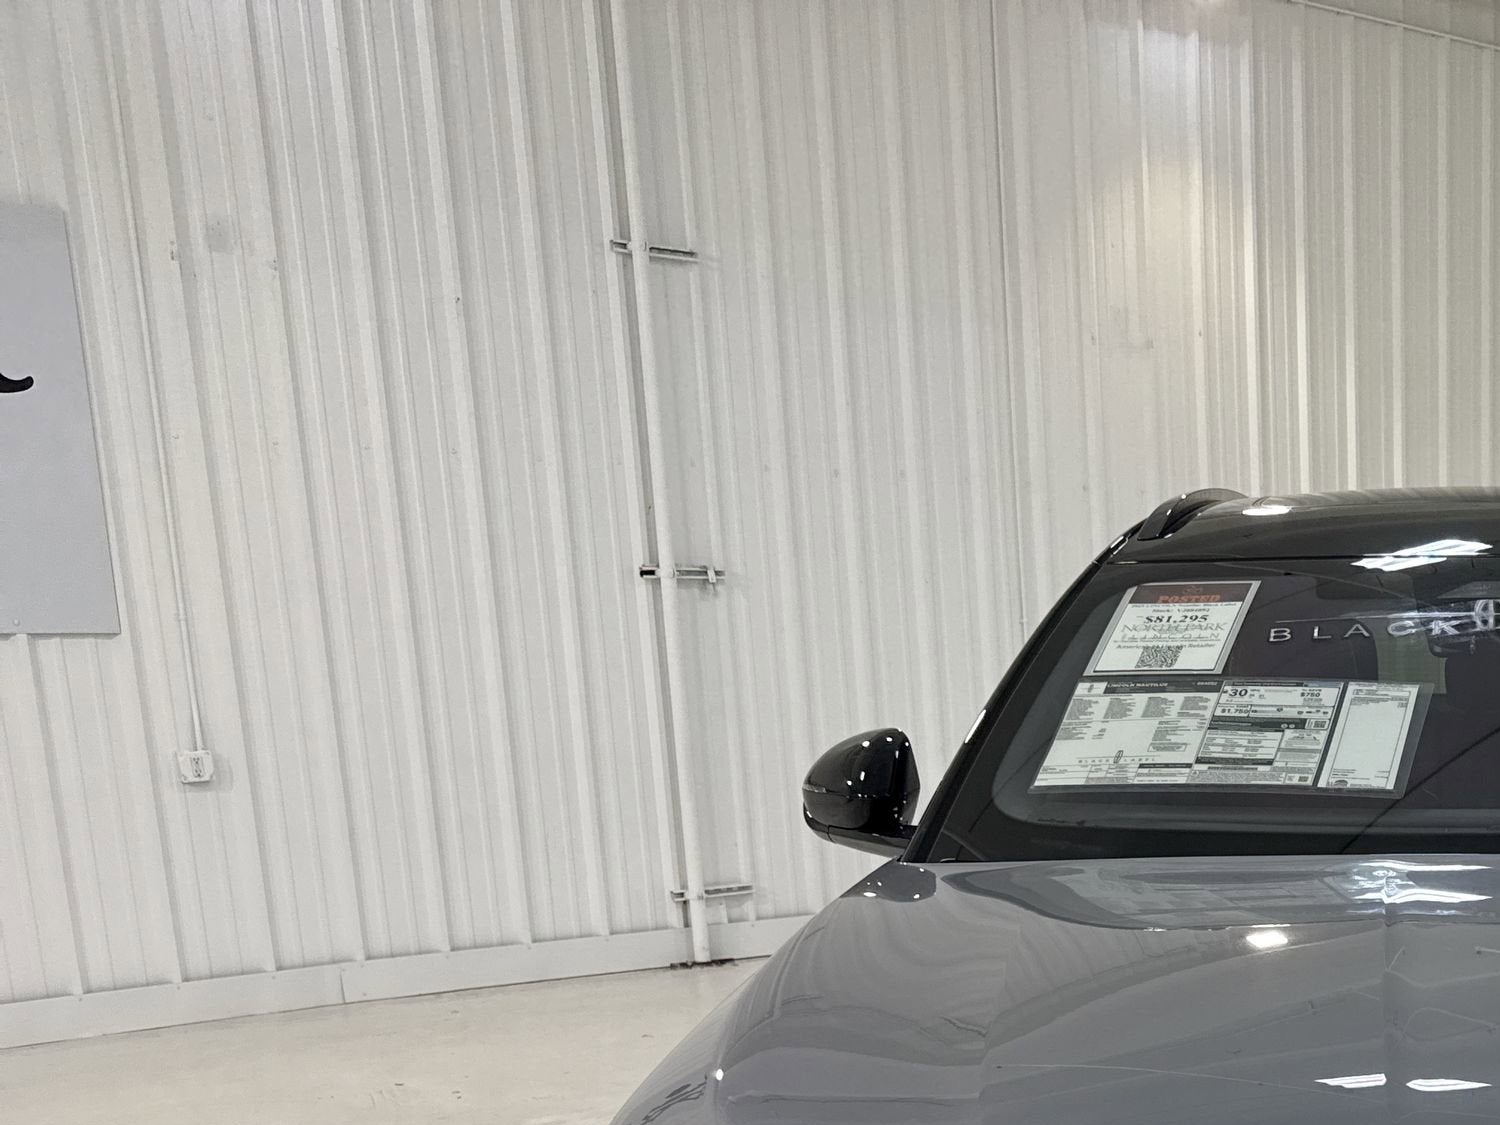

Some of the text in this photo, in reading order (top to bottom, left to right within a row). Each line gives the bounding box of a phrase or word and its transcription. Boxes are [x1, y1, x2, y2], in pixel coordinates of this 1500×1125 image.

[1157, 594, 1222, 604] POSTED
[1143, 614, 1210, 624] $81,295
[1268, 620, 1461, 642] BLACK
[1228, 688, 1249, 697] 30
